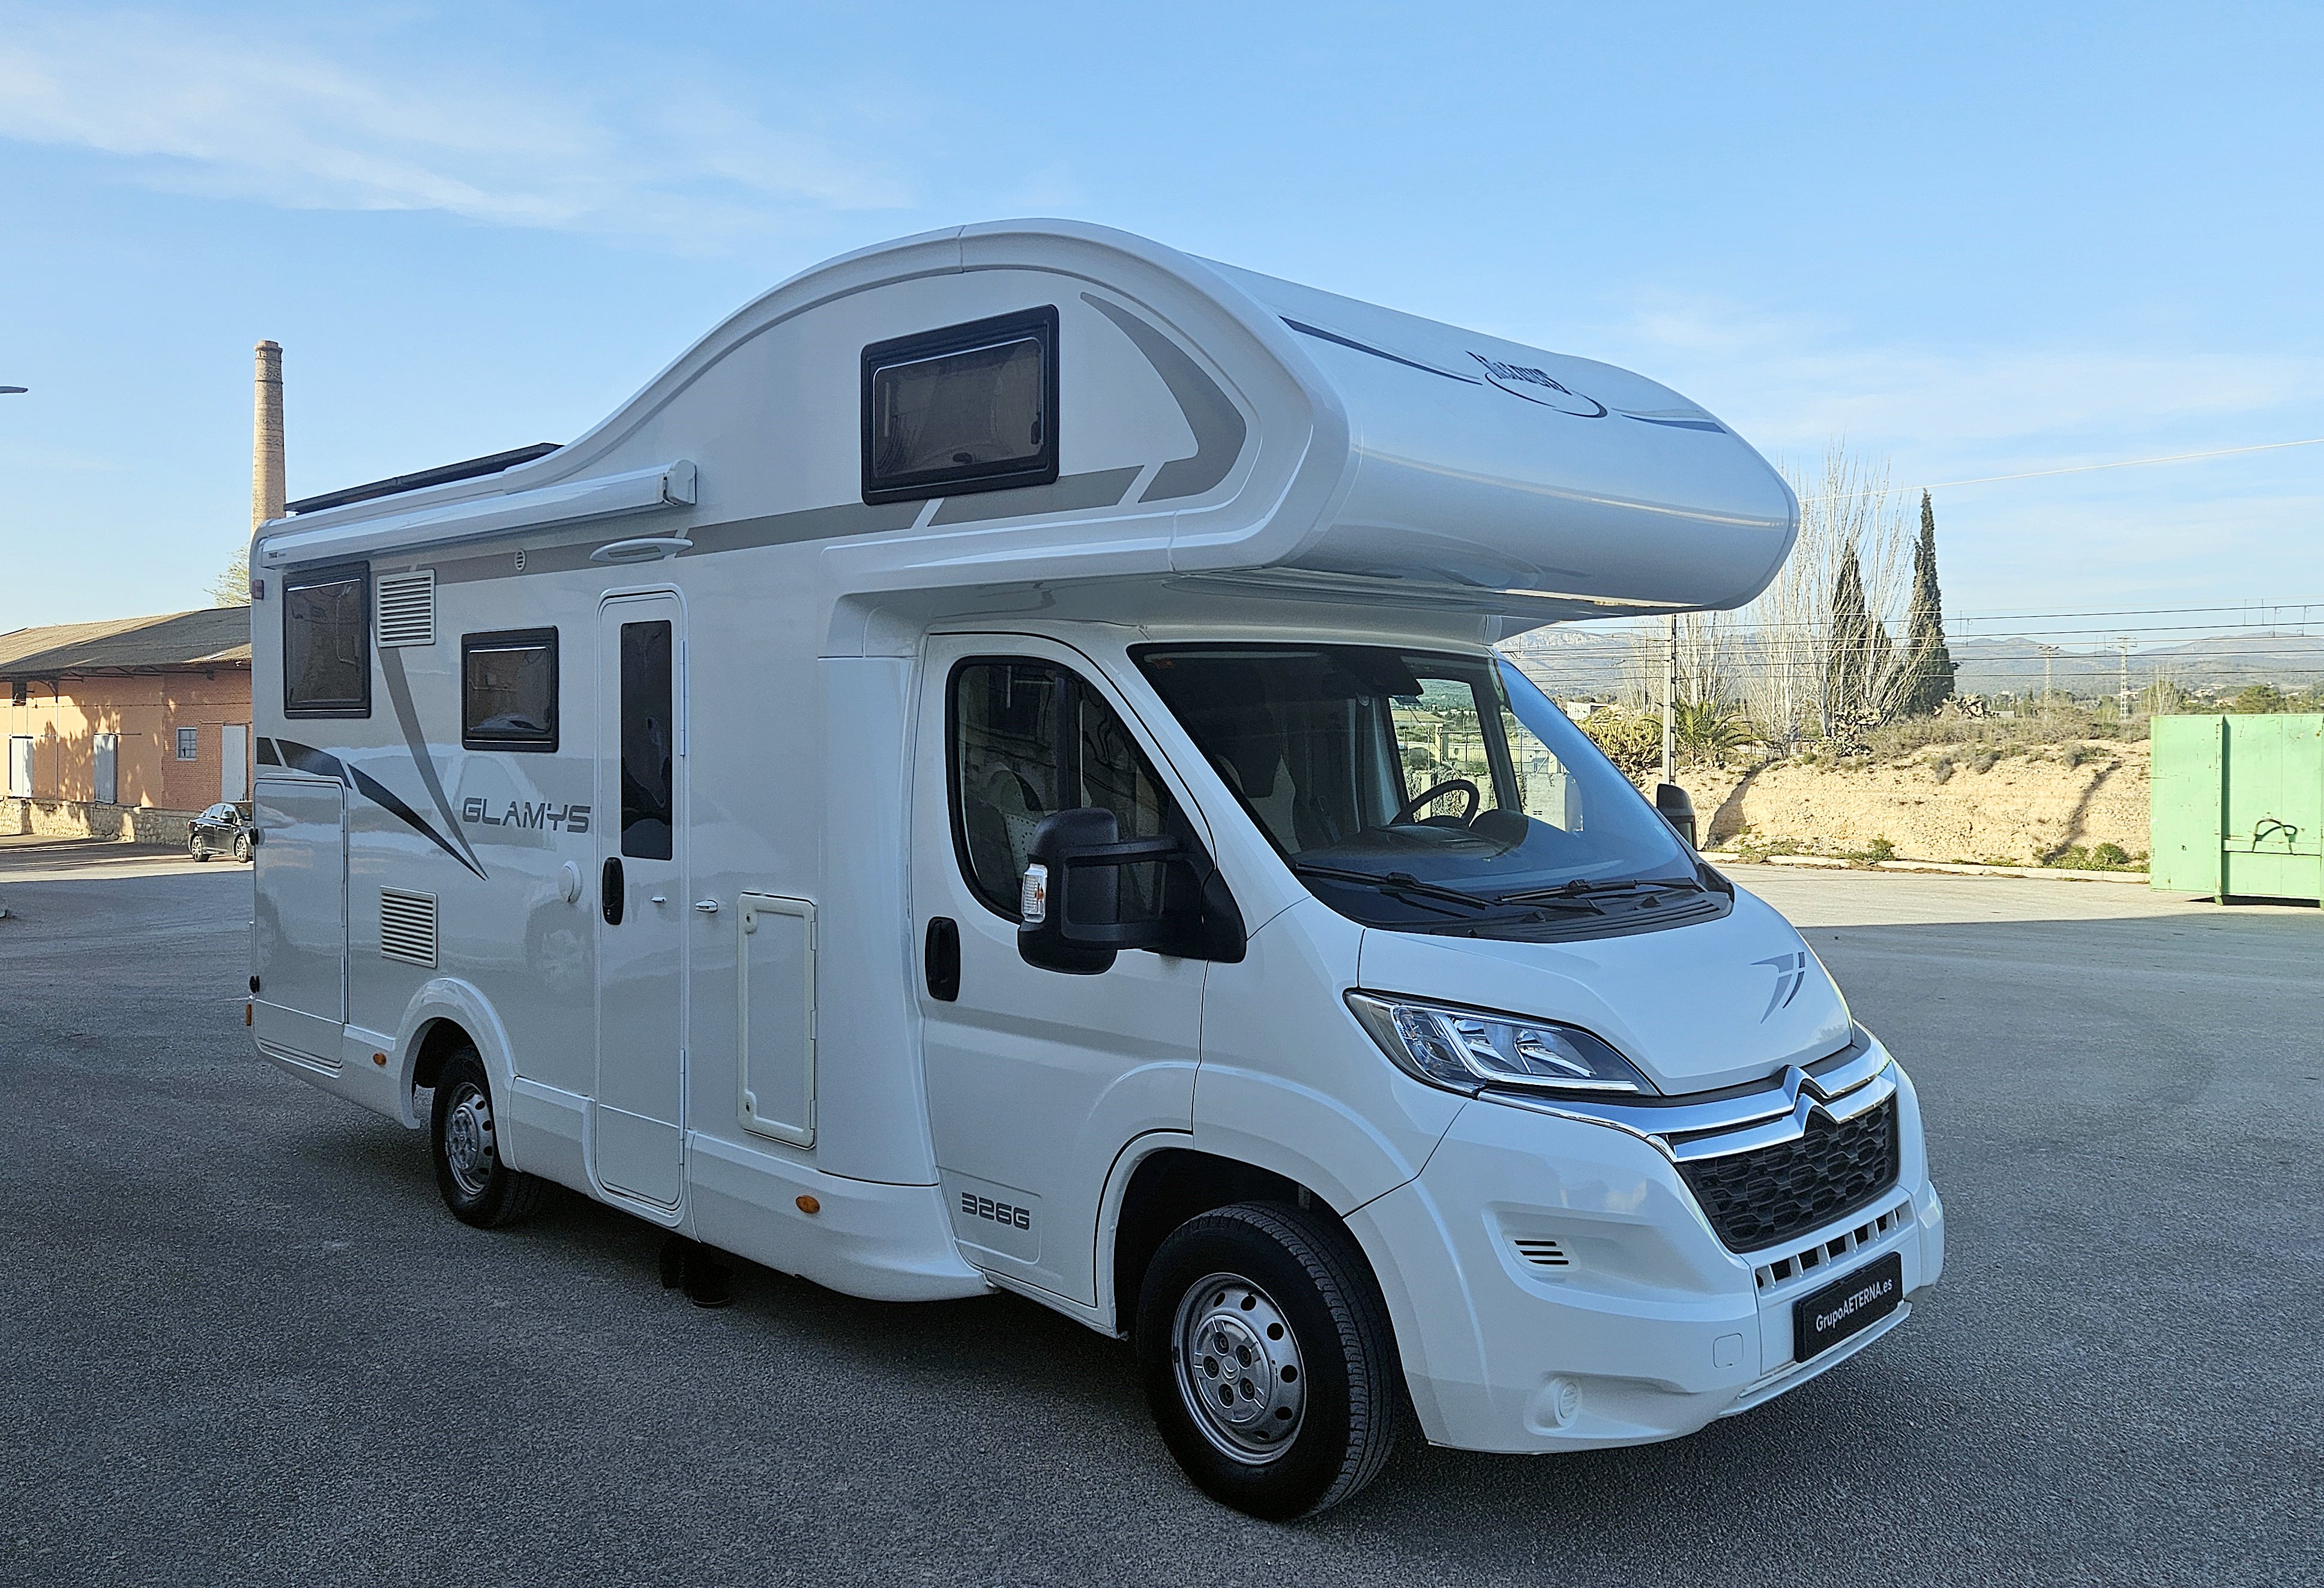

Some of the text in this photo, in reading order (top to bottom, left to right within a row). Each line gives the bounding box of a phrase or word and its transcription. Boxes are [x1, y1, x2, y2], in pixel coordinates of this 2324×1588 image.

[462, 797, 591, 833] GLAMYS
[962, 1192, 1030, 1231] 326G
[1816, 1278, 1892, 1332] GrupoAETERNA.es
